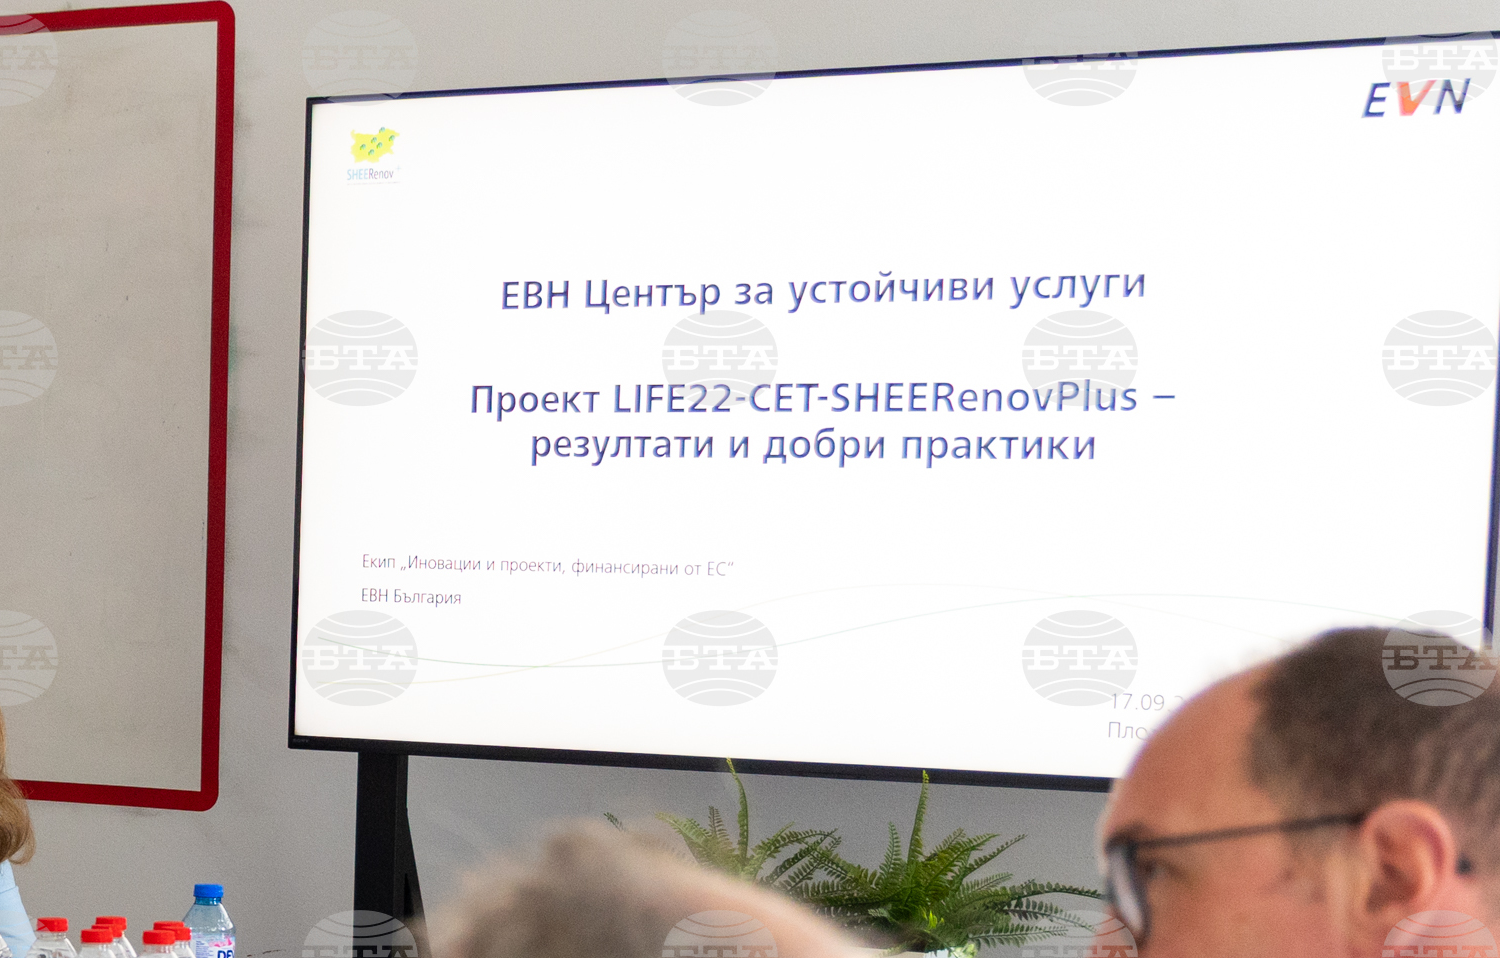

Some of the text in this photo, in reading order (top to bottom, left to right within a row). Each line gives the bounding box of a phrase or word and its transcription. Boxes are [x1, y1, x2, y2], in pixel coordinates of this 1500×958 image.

[1362, 78, 1471, 118] EVN
[501, 270, 1146, 315] ЕВН Център за устойчиви услуги
[471, 385, 601, 422] Проект
[614, 379, 1138, 413] LIFE22-CET-SHEERenovPlus
[531, 427, 1096, 469] резултати и добри практики
[362, 554, 396, 569] Екип
[486, 560, 496, 571] и
[500, 560, 566, 576] проекти,
[571, 558, 679, 579] финансирани
[684, 564, 702, 576] от
[361, 587, 462, 608] ЕВН България
